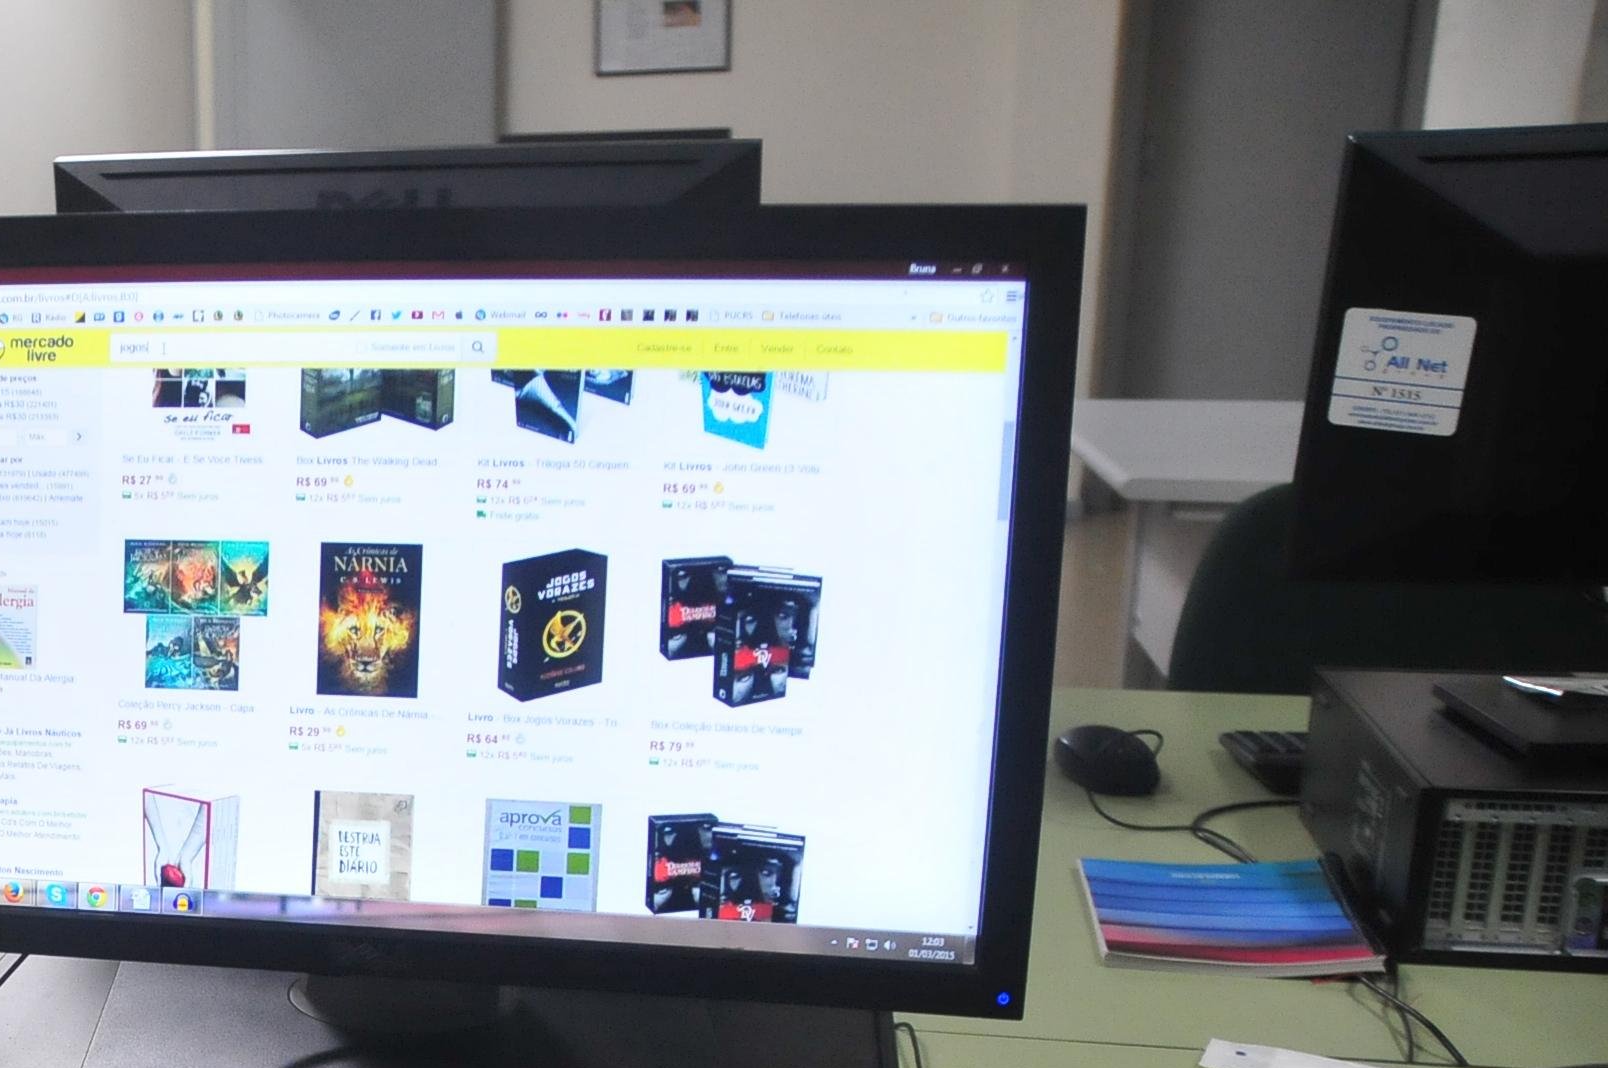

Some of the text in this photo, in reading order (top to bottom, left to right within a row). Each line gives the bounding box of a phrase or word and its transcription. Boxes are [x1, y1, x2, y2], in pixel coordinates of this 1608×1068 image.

[909, 263, 937, 275] Bruna
[490, 311, 526, 320] Webmail
[9, 334, 74, 349] mercado
[761, 343, 794, 353] Vender
[26, 348, 57, 362] livre
[816, 343, 854, 354] Contato
[1386, 355, 1410, 370] All
[1416, 357, 1449, 374] Net
[9, 374, 37, 385] preços
[203, 409, 233, 423] ficar
[316, 456, 348, 466] Livros
[351, 457, 370, 466] The
[372, 456, 410, 469] Walking
[411, 457, 438, 466] Dead
[492, 458, 526, 469] Livros
[678, 461, 712, 473] Livros
[121, 475, 152, 486] R$ 27
[296, 476, 328, 488] R$ 69
[476, 478, 509, 490] R$ 74
[663, 482, 697, 495] R$ 69
[333, 550, 408, 573] NÁRNIA
[545, 569, 588, 590] JOGOS
[537, 578, 597, 601] VORAZES
[117, 699, 255, 715] Coleção Percy Jackson Capa
[289, 705, 316, 716] Livro
[323, 706, 336, 716] As
[338, 706, 379, 718] Crônicas
[117, 719, 148, 731] R$ 69
[467, 713, 495, 723] Livro
[524, 715, 553, 728] Jogos
[555, 716, 595, 727] Vorazes
[16, 727, 43, 737] Livros
[45, 727, 82, 739] Náuticos
[288, 725, 320, 737] R$ 29
[671, 722, 712, 735] Coleção
[466, 733, 499, 745] R$ 64
[649, 741, 683, 754] R$ 79
[498, 808, 563, 828] aprova
[337, 829, 382, 847] DESTRUA
[339, 845, 360, 858] ESTE
[14, 865, 64, 878] Nascimento
[338, 857, 378, 875] DIÁRIO
[920, 936, 945, 947] 12:03
[907, 948, 956, 961] 01/03/2015
